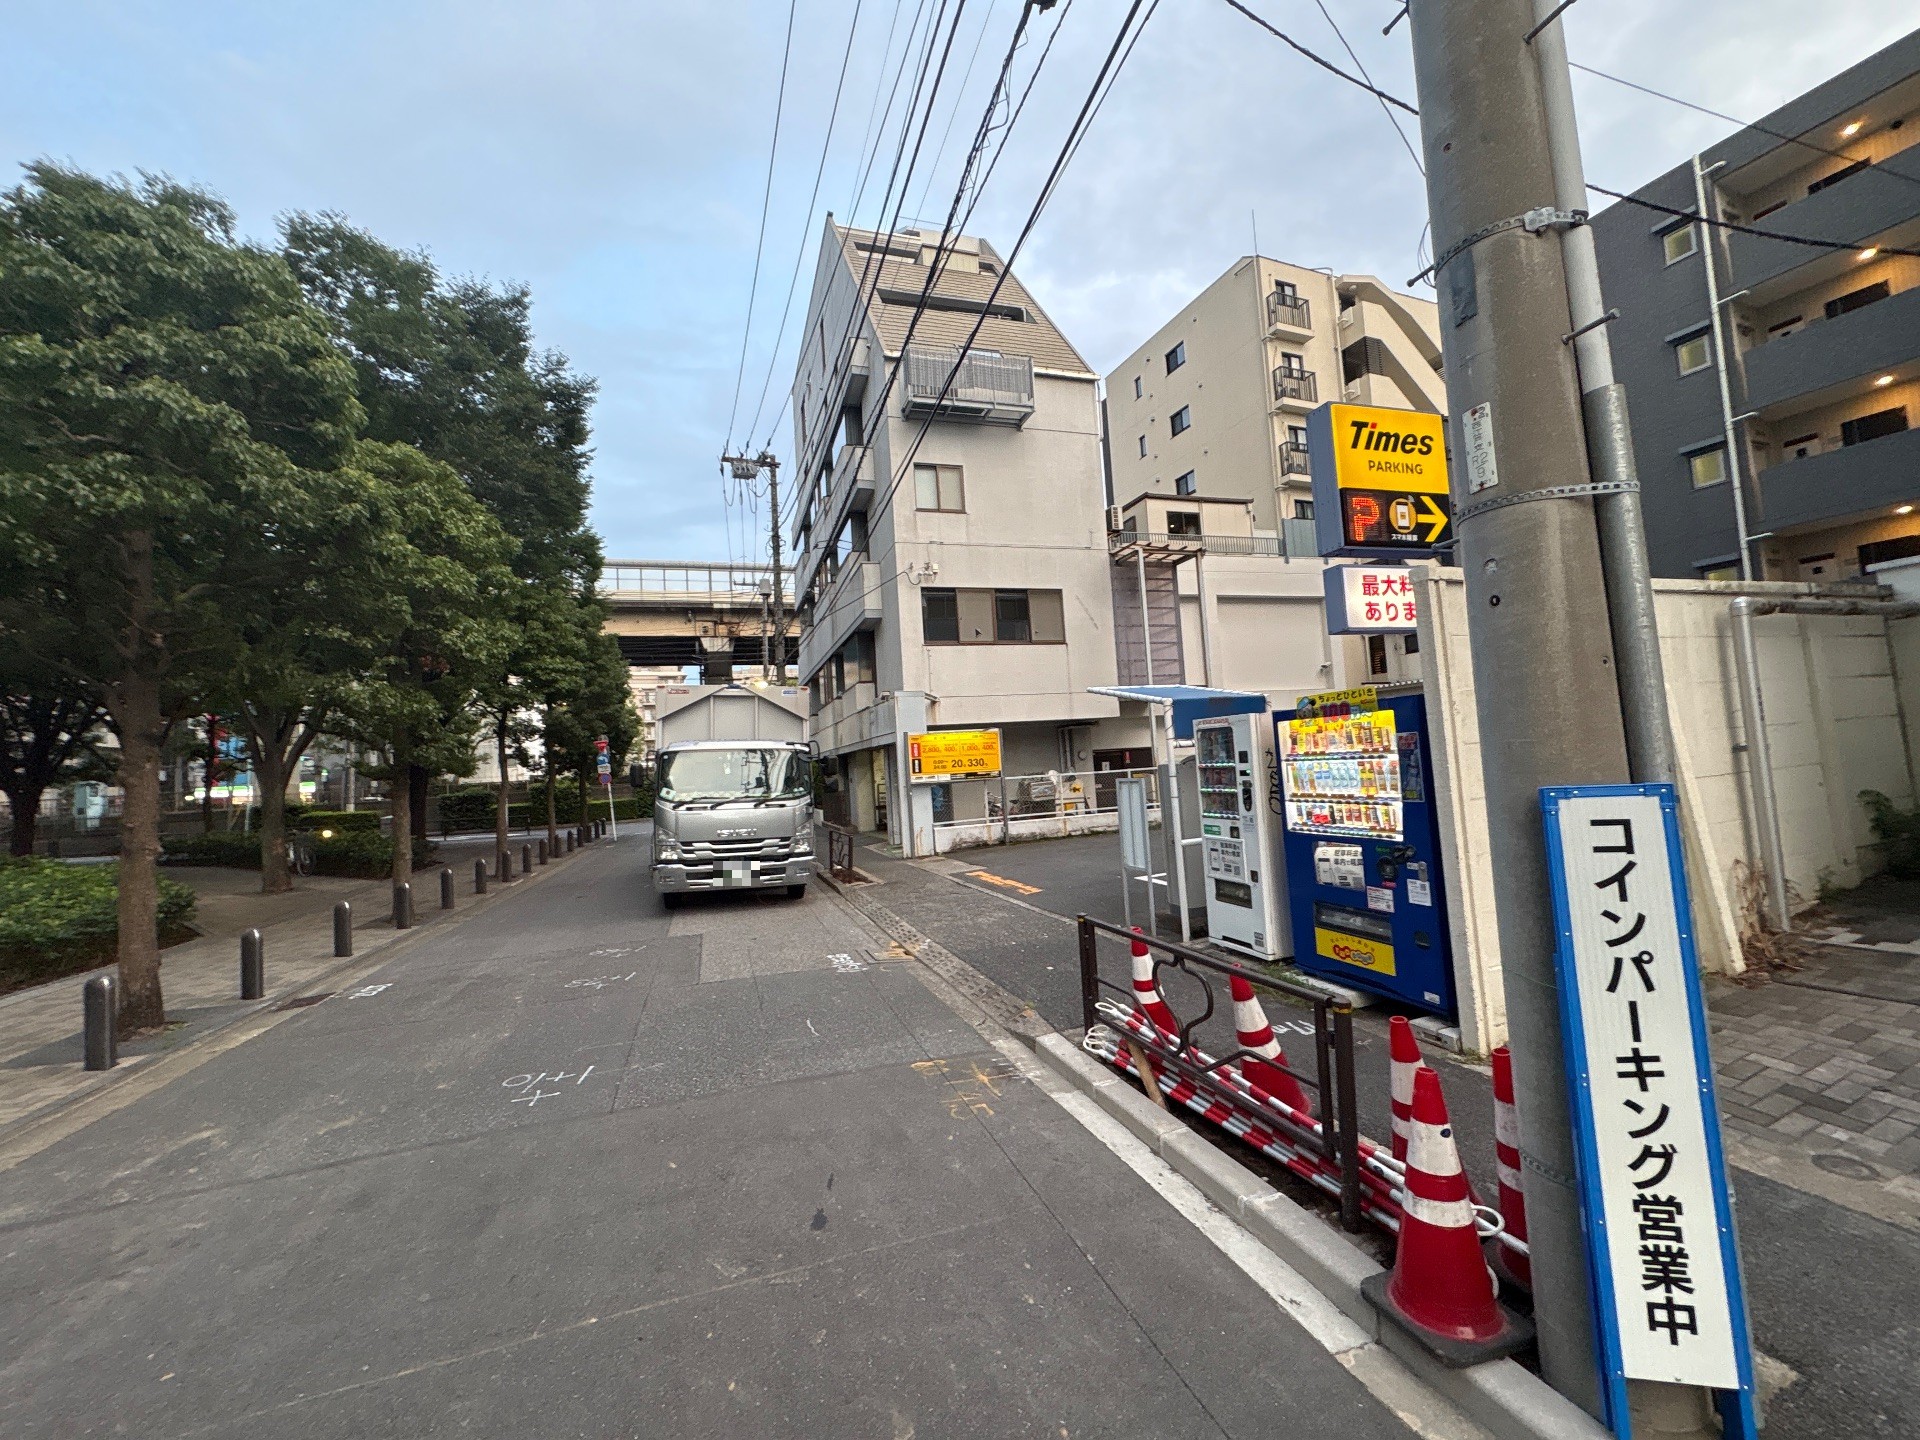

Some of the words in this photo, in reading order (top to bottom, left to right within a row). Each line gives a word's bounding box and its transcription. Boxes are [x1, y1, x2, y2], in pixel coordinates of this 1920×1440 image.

[1350, 420, 1434, 456] Times
[1368, 460, 1423, 475] PARKING
[1589, 818, 1699, 1346] コインパーキング営業中
